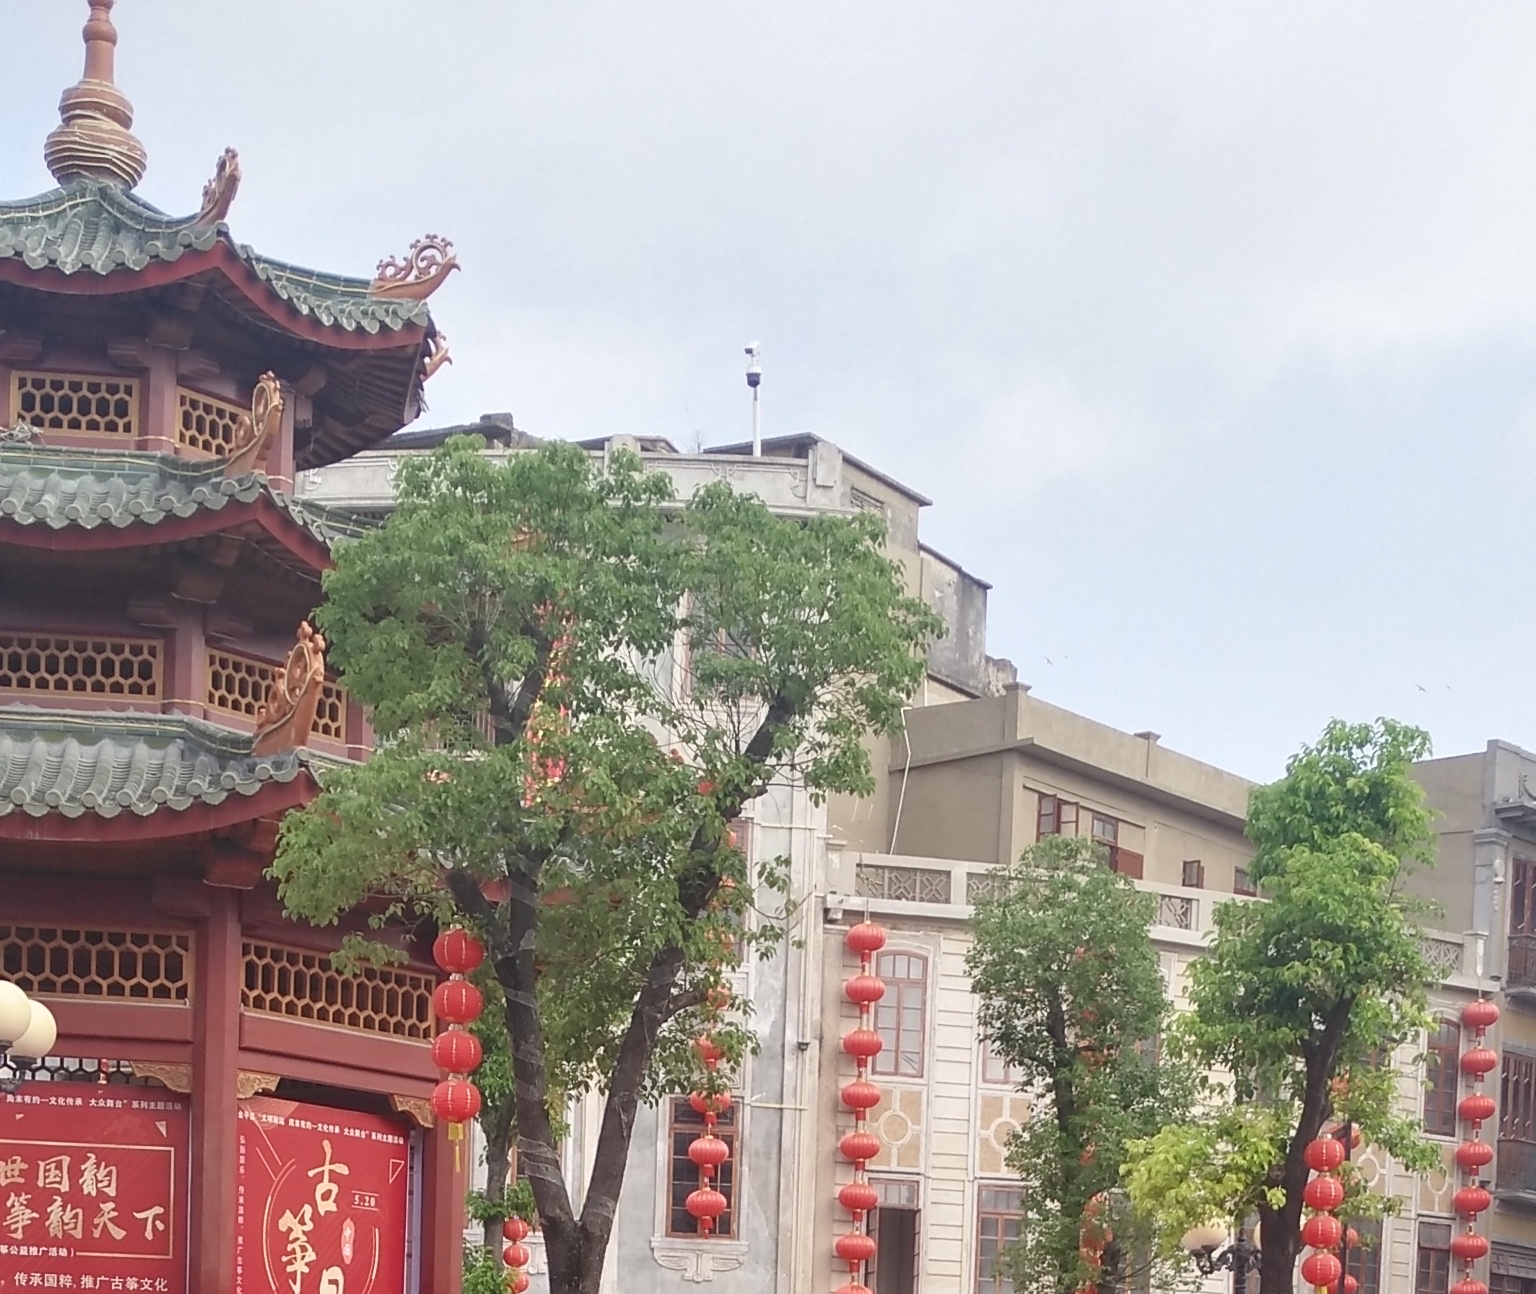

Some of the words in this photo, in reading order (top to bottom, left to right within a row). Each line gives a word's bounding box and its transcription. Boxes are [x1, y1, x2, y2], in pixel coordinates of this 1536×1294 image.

[3, 1191, 167, 1241] 筝韵天下
[354, 1195, 376, 1207] 5.20
